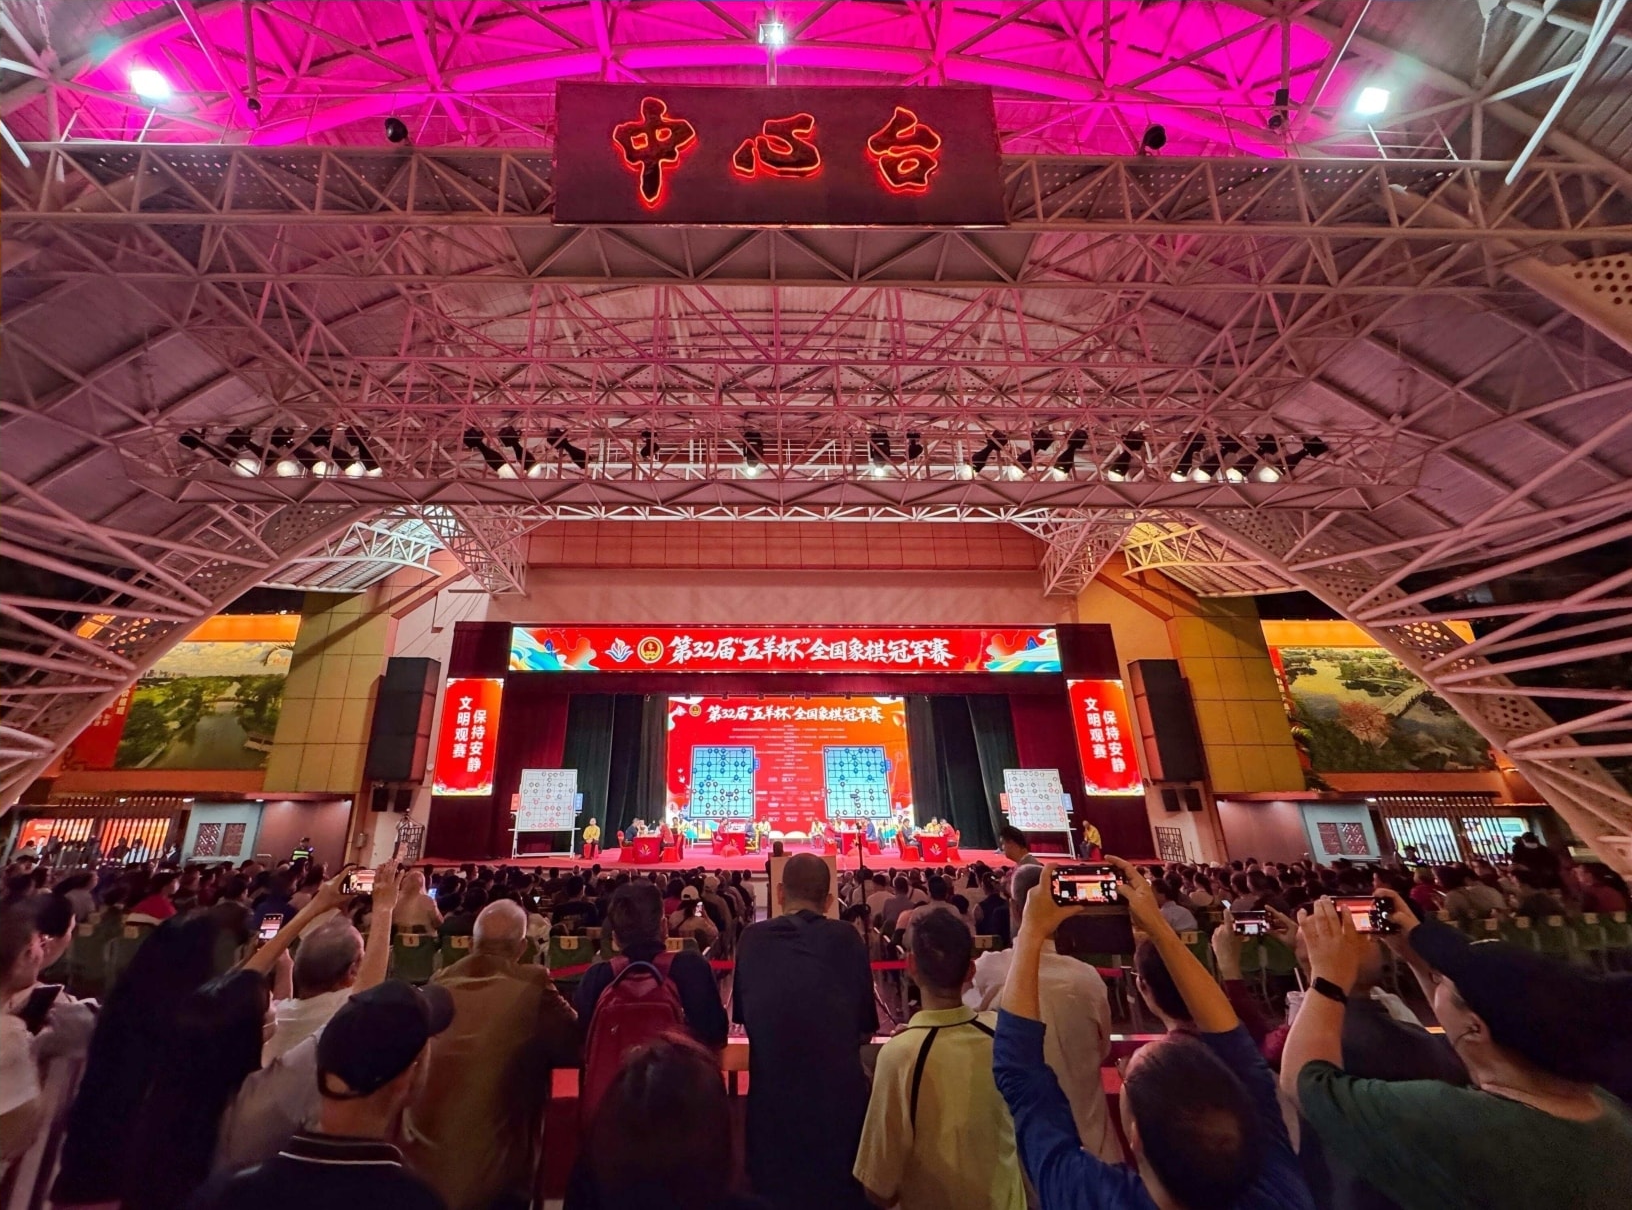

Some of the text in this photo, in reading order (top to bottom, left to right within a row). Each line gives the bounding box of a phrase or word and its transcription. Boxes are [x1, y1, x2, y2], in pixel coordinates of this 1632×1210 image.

[613, 97, 942, 207] 中心台
[667, 635, 956, 667] 第32届“五羊杯”全国象棋冠军赛
[452, 696, 473, 758] 文明观赛
[467, 709, 487, 772] 保持安静
[1083, 697, 1107, 759] 文明观赛
[1102, 710, 1126, 773] 保持安静
